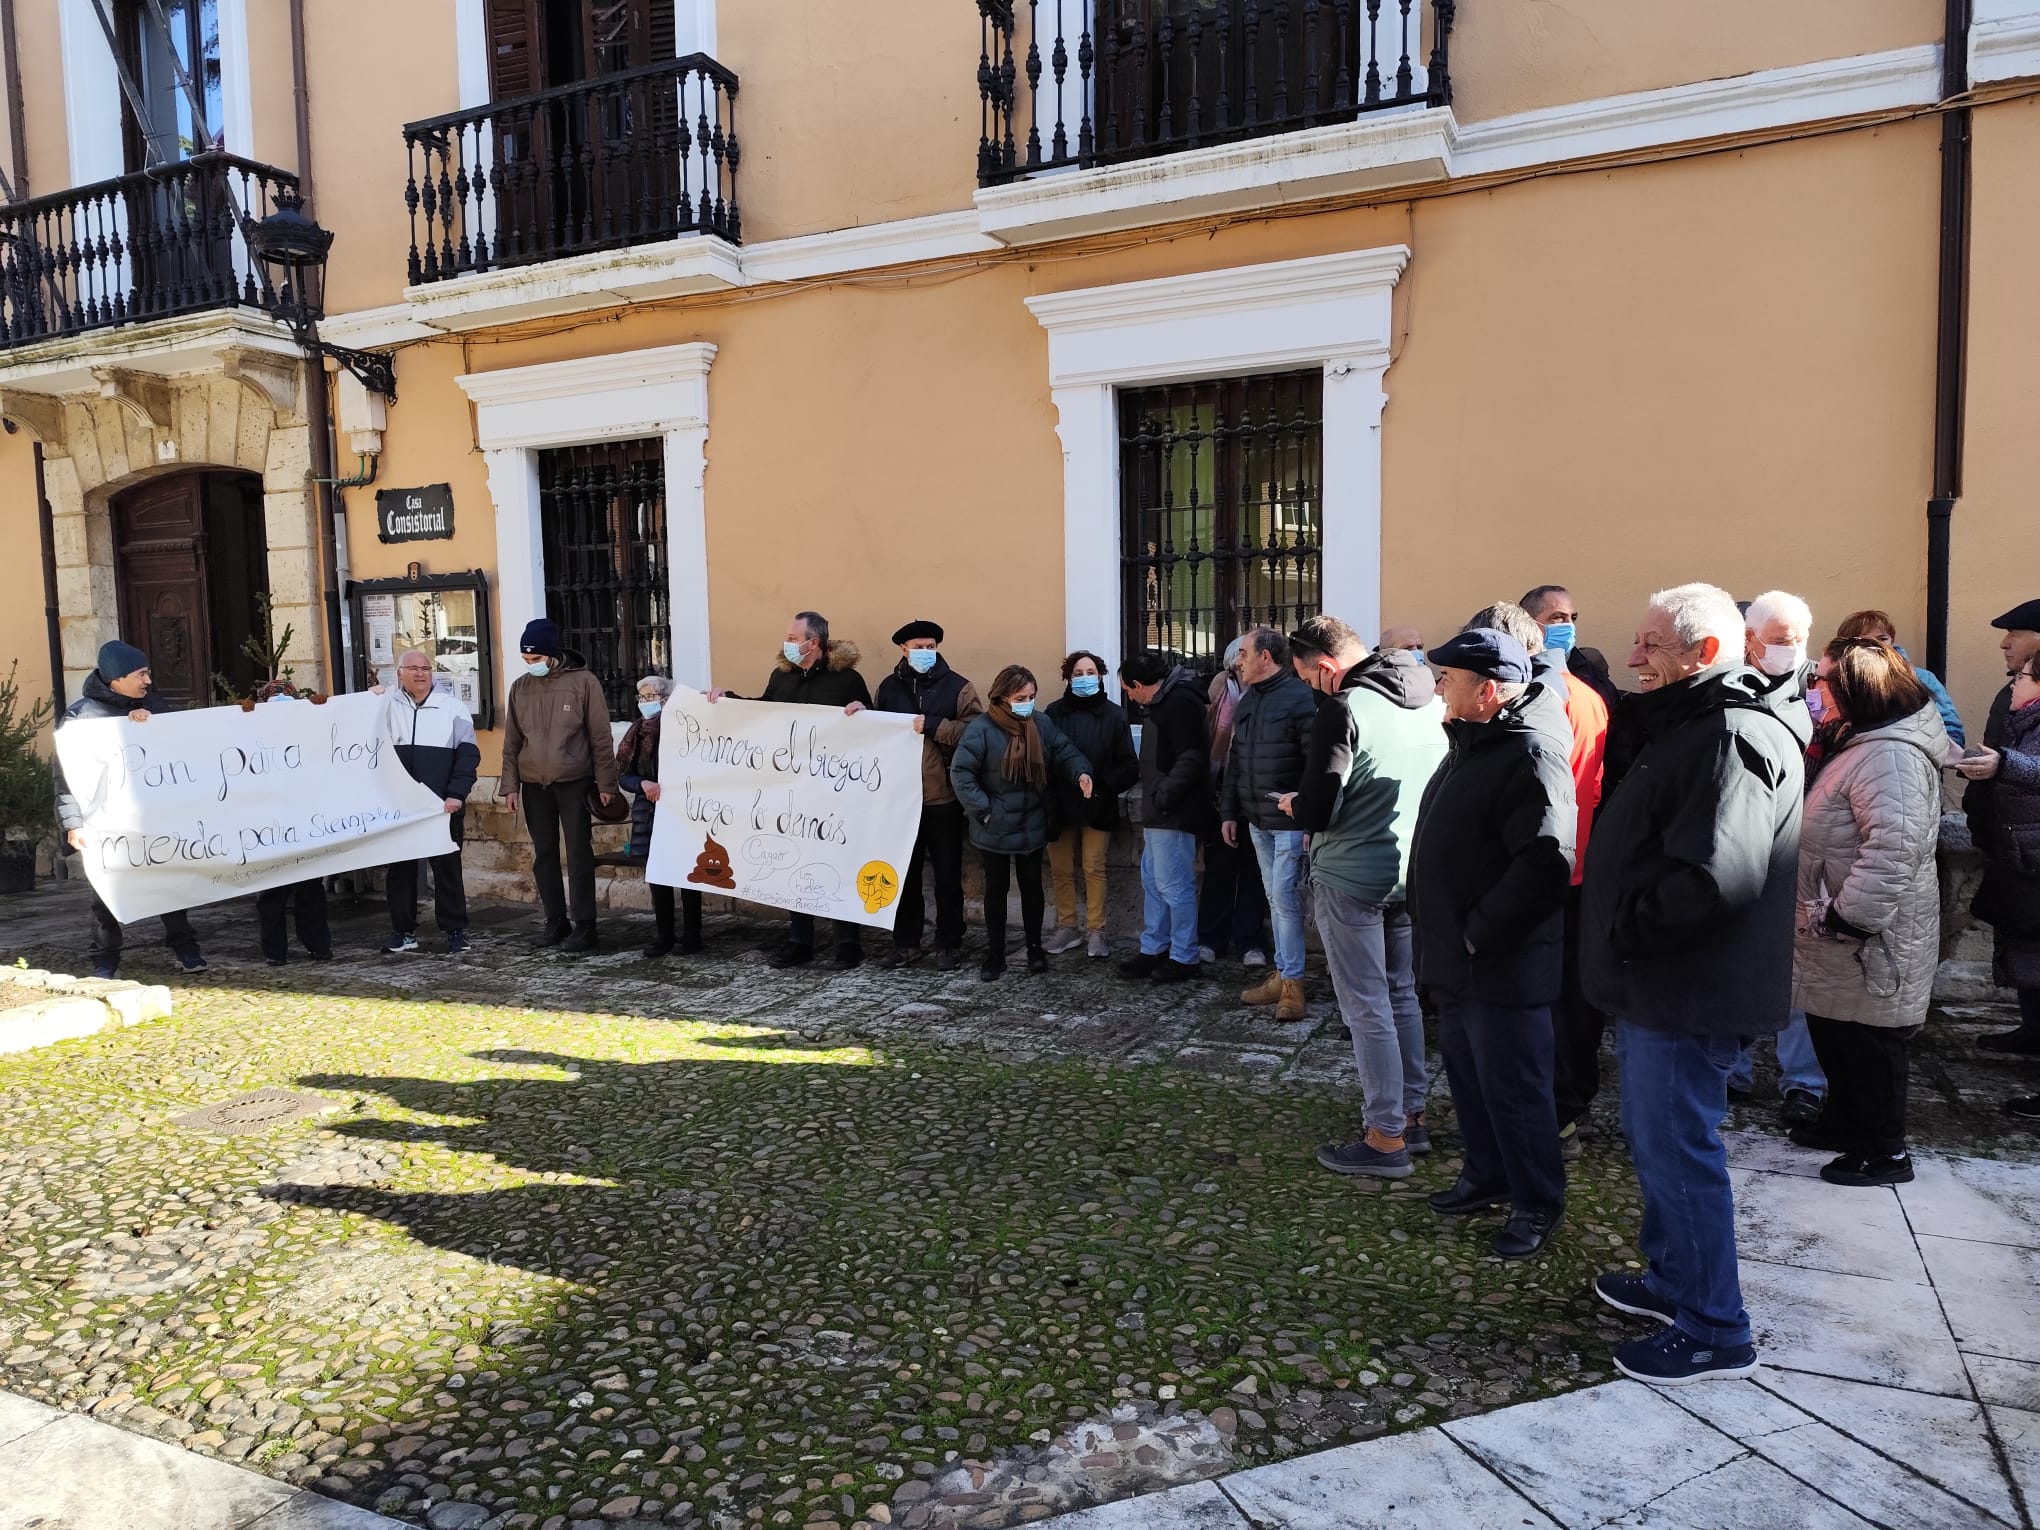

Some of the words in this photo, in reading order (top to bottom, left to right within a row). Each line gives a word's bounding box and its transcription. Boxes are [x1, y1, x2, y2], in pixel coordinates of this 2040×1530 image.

[386, 506, 446, 536] Consistorial
[406, 494, 423, 512] Casa
[118, 743, 198, 789] Pan
[217, 741, 303, 801] para
[330, 722, 385, 769] hoy
[675, 709, 764, 770] Primero
[772, 719, 801, 774] el
[808, 725, 882, 792] biogás
[685, 775, 735, 836] luego
[750, 788, 766, 831] lo
[775, 789, 847, 845] demás
[236, 817, 301, 866] para
